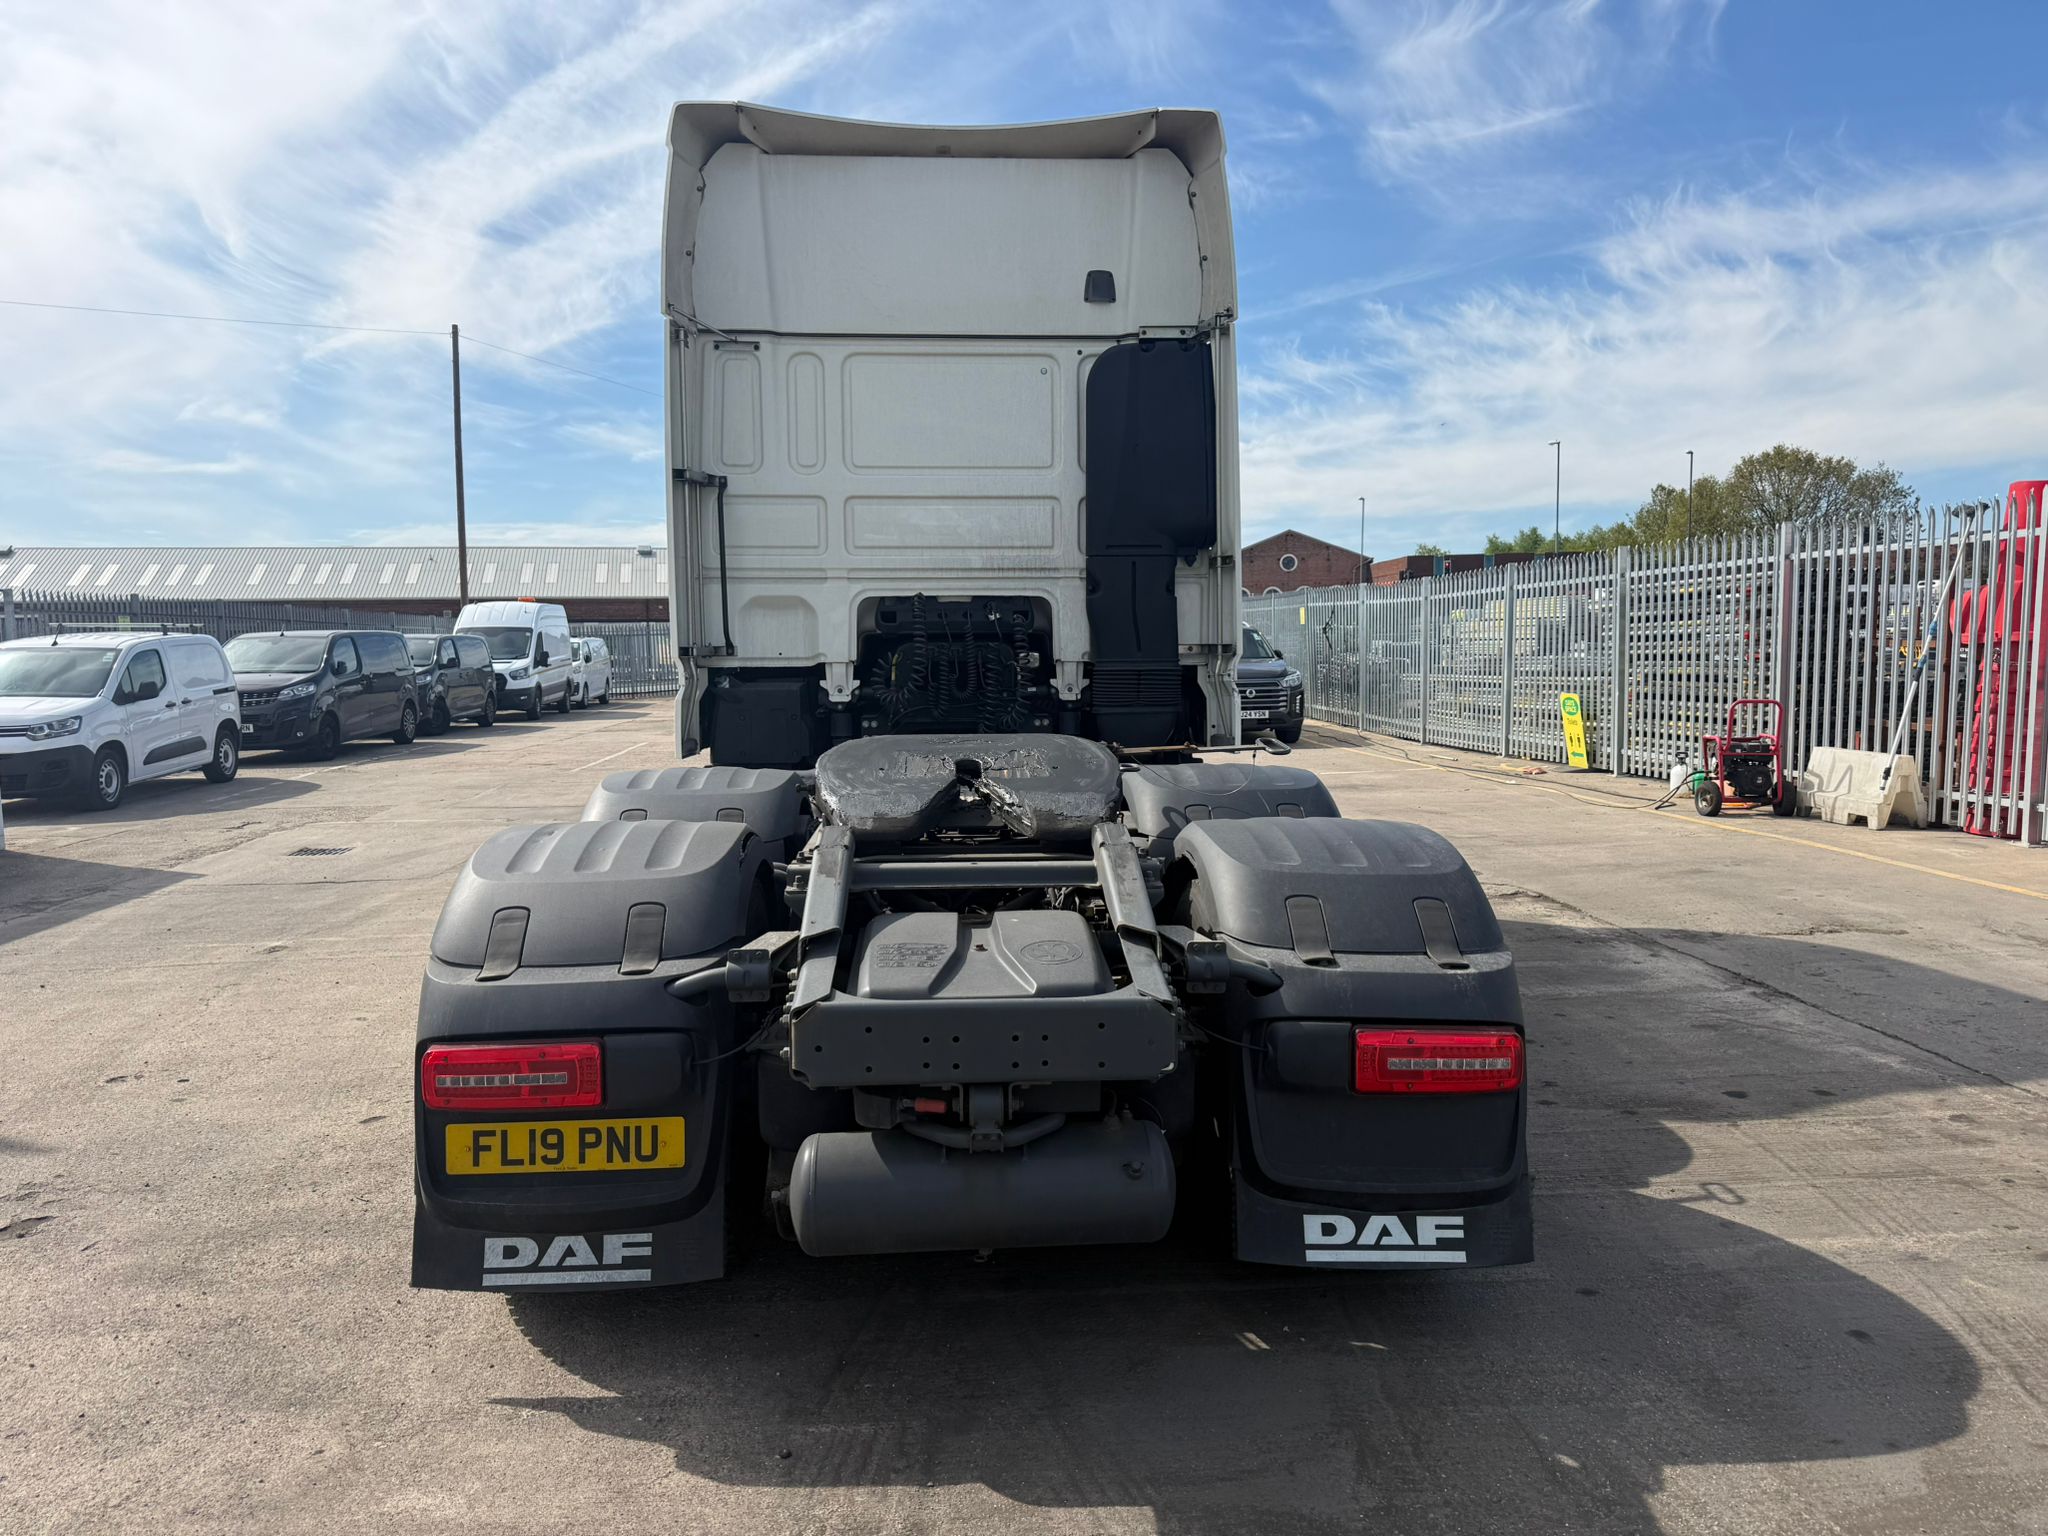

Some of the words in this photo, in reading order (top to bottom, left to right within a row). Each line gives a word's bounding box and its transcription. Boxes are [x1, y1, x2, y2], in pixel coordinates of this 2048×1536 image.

[472, 1128, 564, 1167] FL19
[578, 1125, 659, 1164] PNU
[1303, 1214, 1465, 1245] DAF
[483, 1232, 653, 1269] DAF
